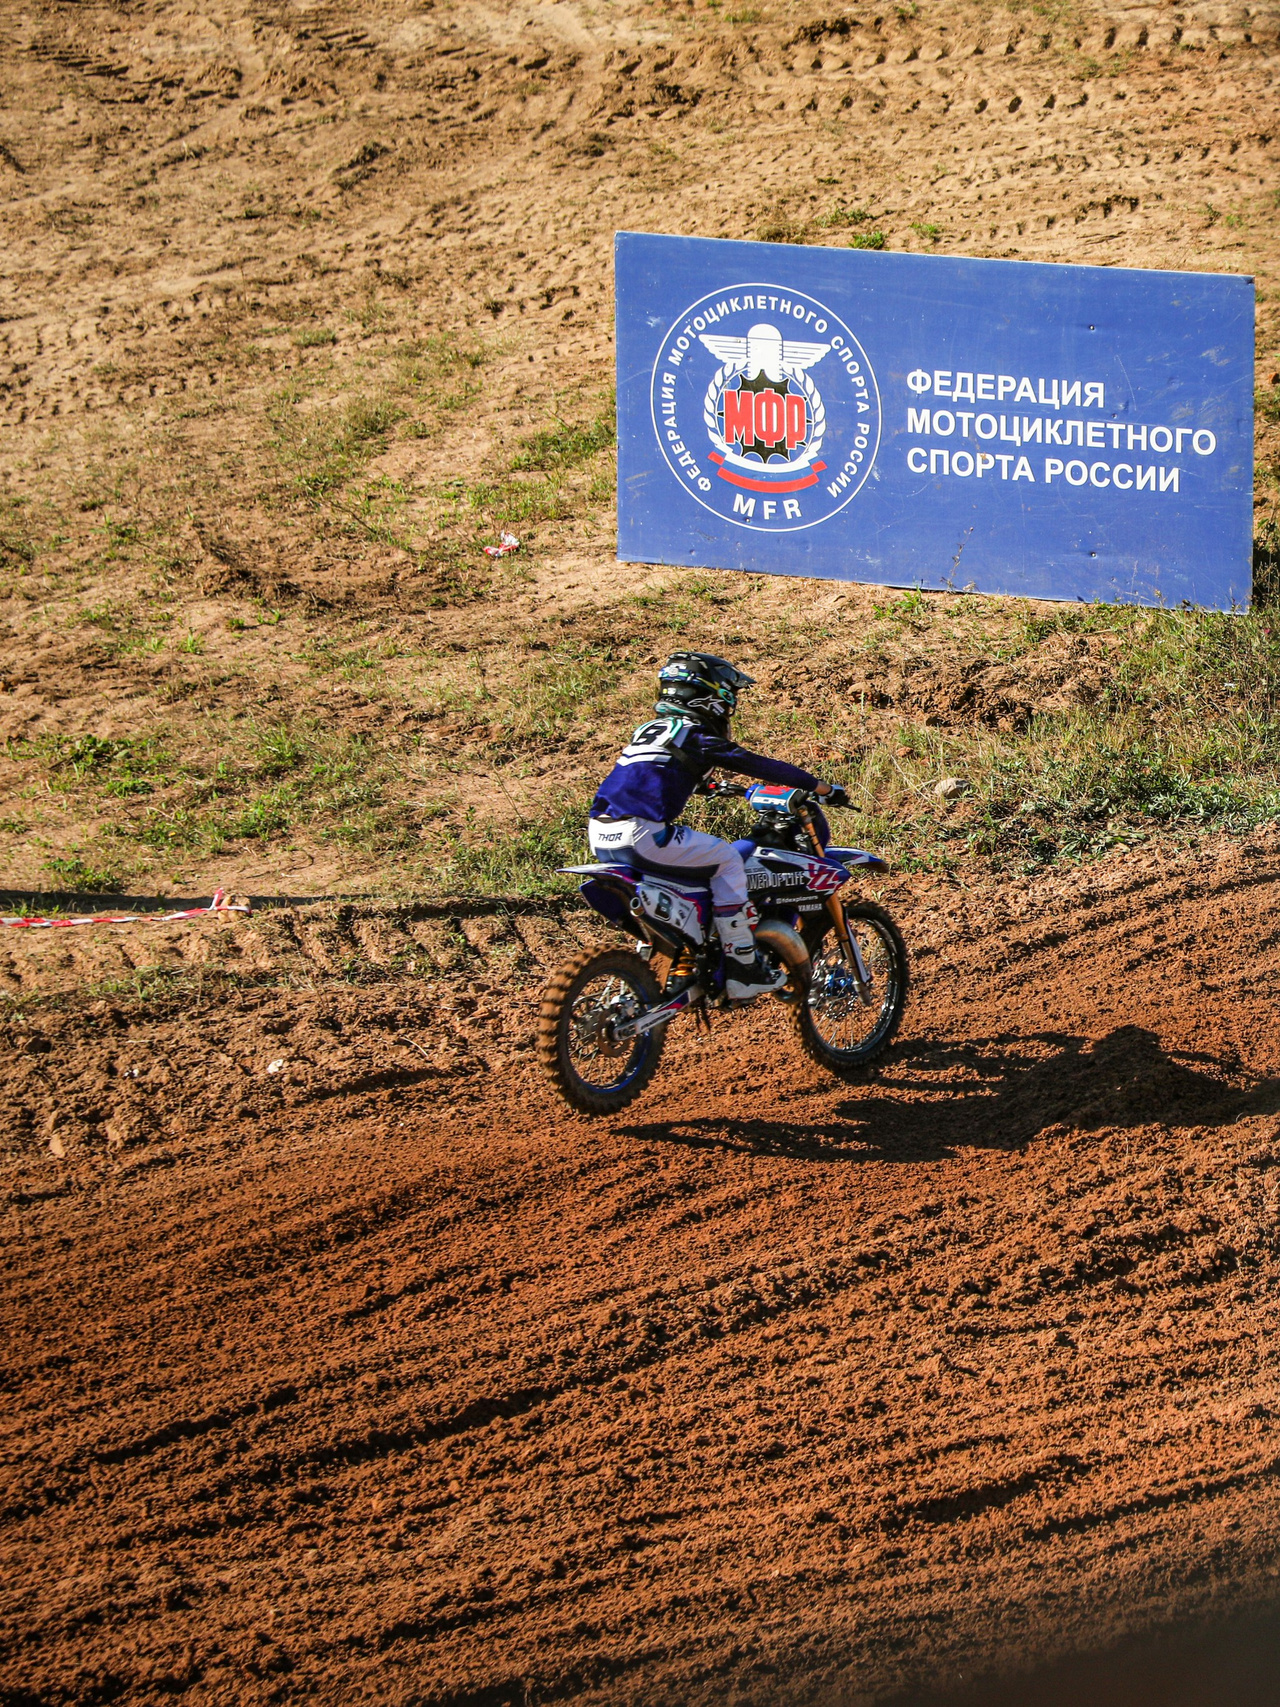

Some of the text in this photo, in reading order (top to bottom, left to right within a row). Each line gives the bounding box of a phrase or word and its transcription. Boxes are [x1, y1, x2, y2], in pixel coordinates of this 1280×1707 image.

[661, 295, 872, 498] ФЕДЕРАЦИЯ МОТОЦИКЛЕТНОГО СПОРТА РОССИИ
[906, 368, 1104, 409] ФЕДЕРАЦИЯ
[723, 388, 807, 449] МФР
[907, 407, 1217, 456] МОТОЦИКЛЕТНОГО
[907, 447, 1179, 493] СПОРТА РОССИИ
[733, 493, 802, 520] MFR
[752, 796, 787, 807] SCAR
[598, 832, 623, 842] THOR
[655, 891, 672, 919] 8
[798, 903, 823, 912] YAMAHA
